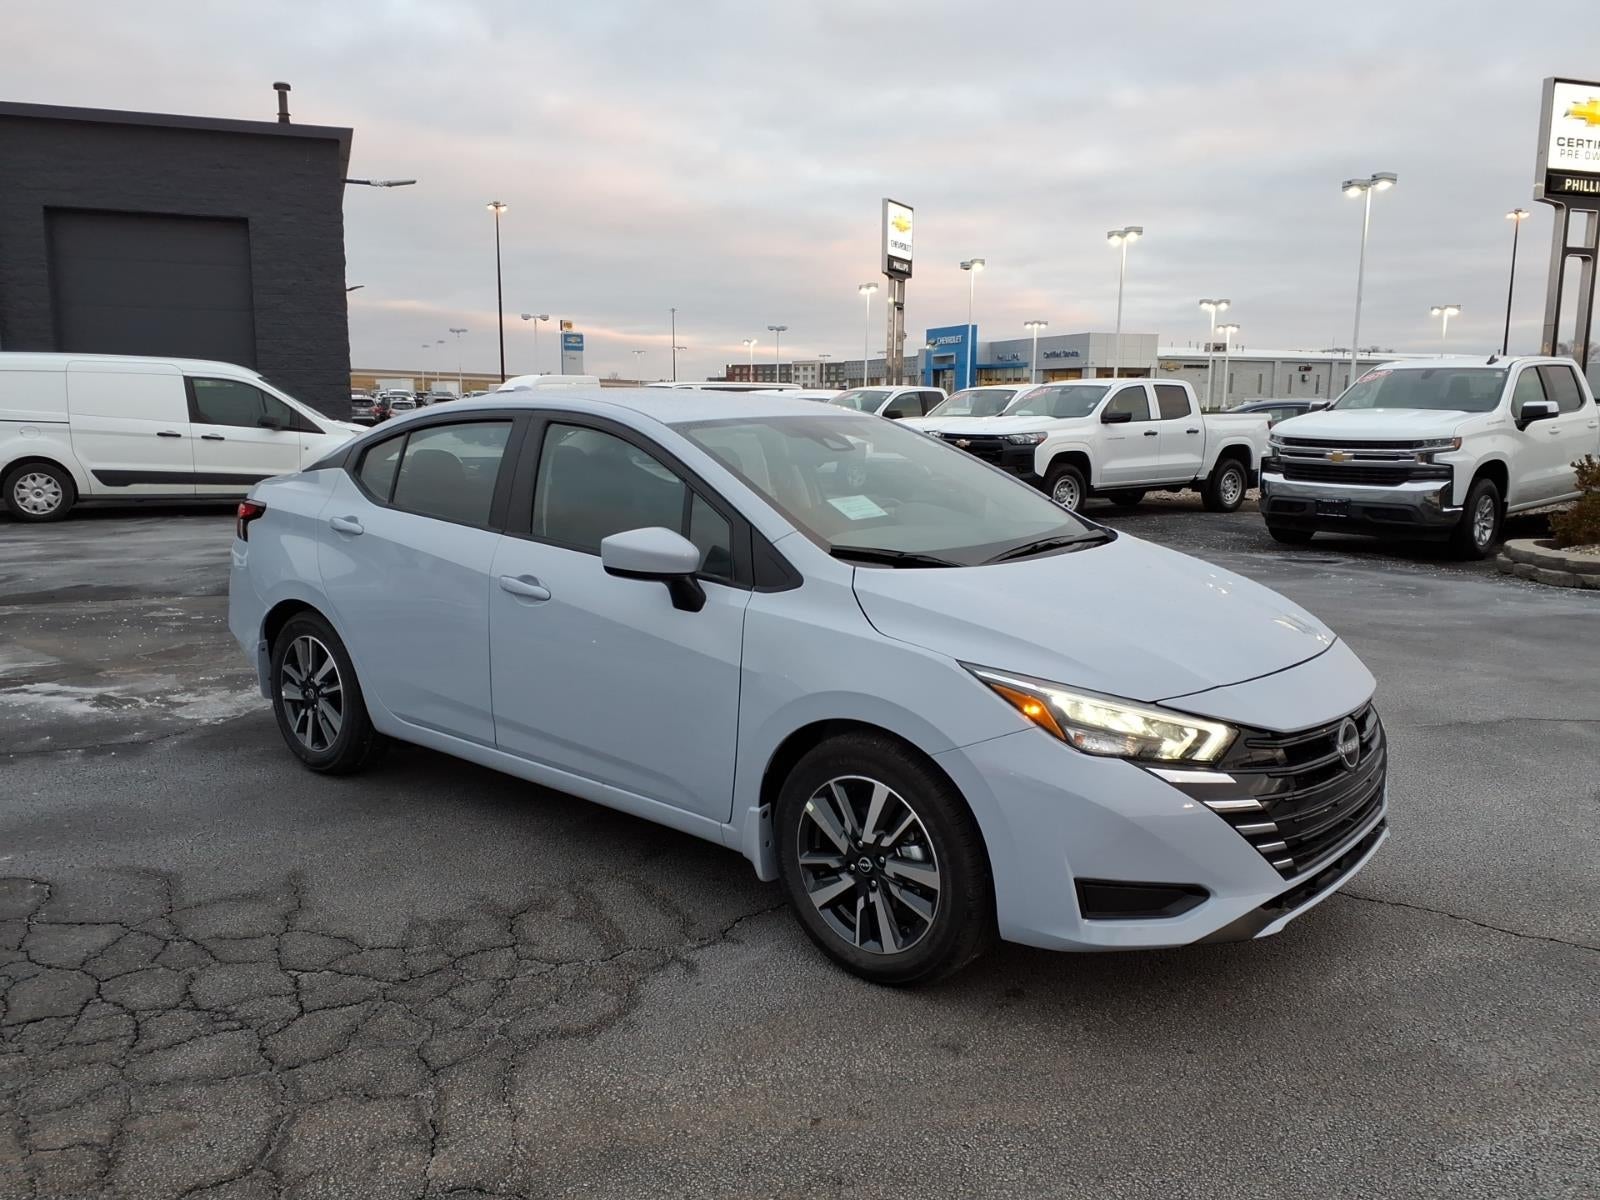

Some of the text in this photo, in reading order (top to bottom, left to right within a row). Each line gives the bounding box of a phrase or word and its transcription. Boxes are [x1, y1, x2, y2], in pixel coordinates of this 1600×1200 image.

[1560, 148, 1580, 159] PRE
[1564, 178, 1600, 193] PHILLI
[936, 335, 962, 345] CHEVROLET
